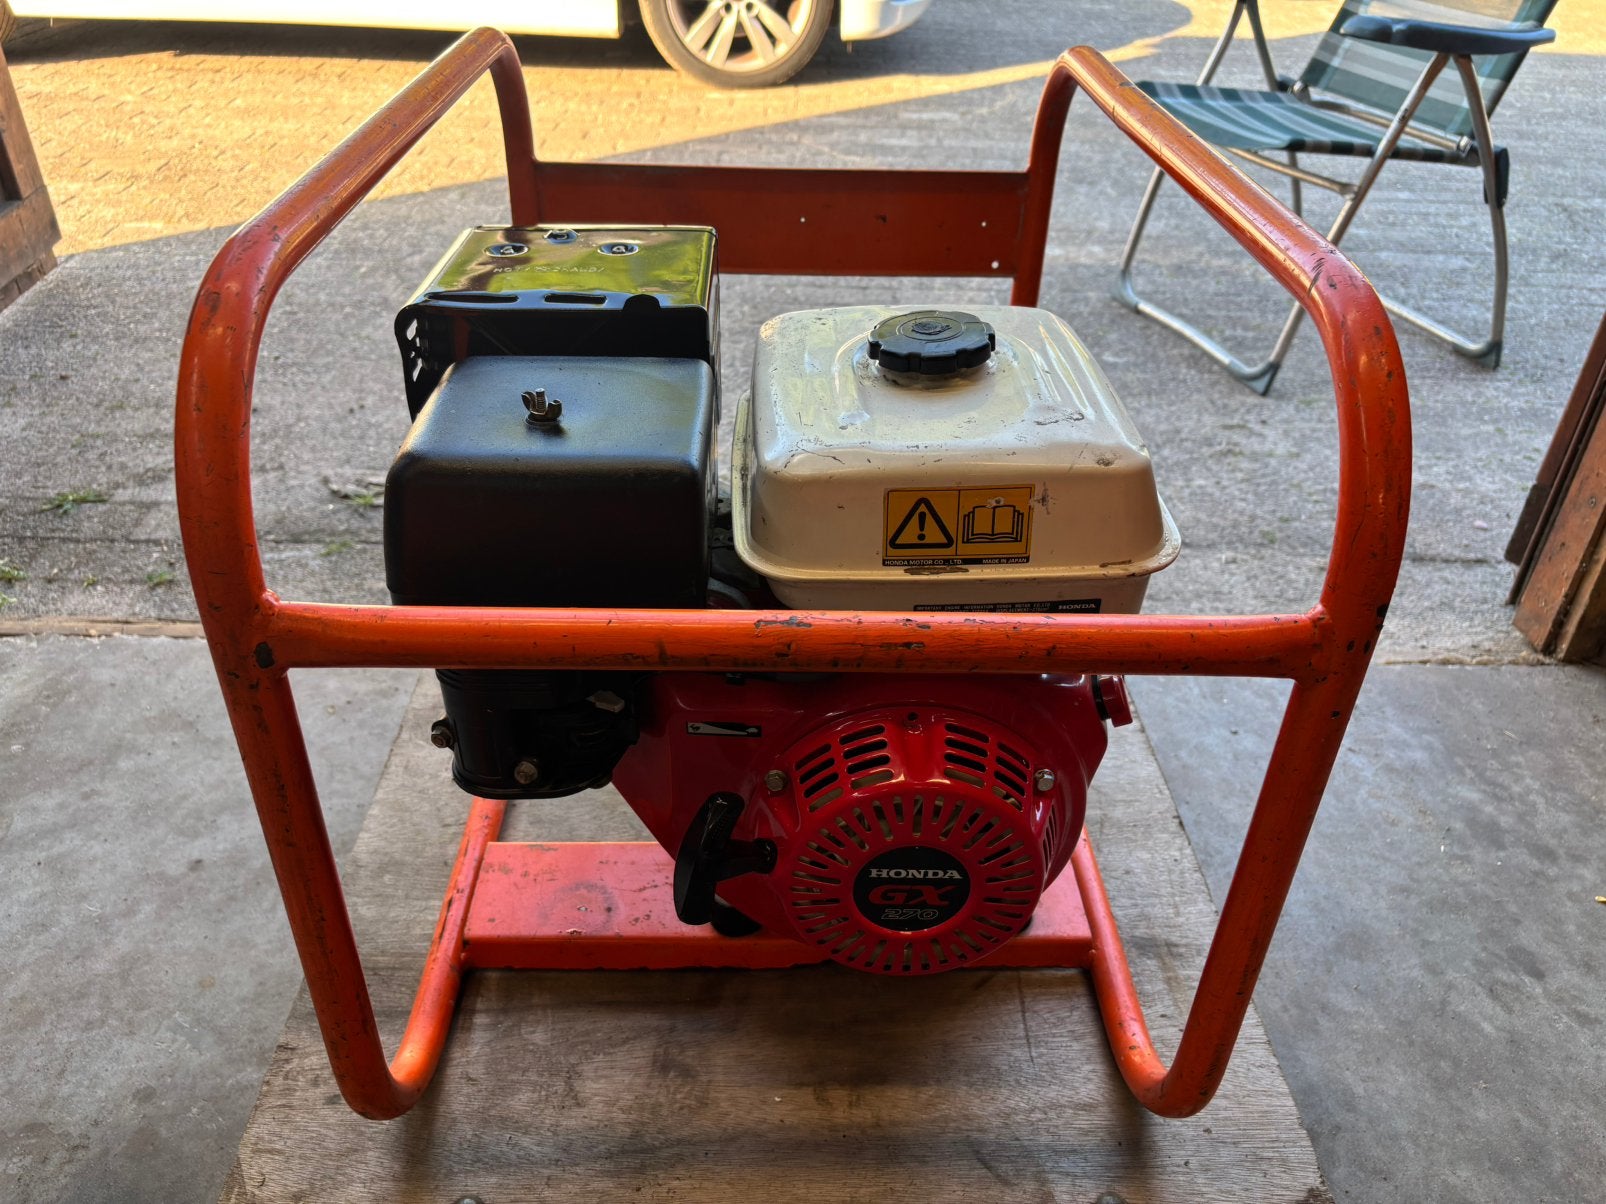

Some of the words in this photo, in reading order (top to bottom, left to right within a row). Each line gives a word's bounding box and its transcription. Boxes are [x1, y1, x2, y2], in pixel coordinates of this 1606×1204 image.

[869, 868, 964, 880] HONDA
[868, 885, 958, 906] GX
[881, 908, 940, 920] 270
